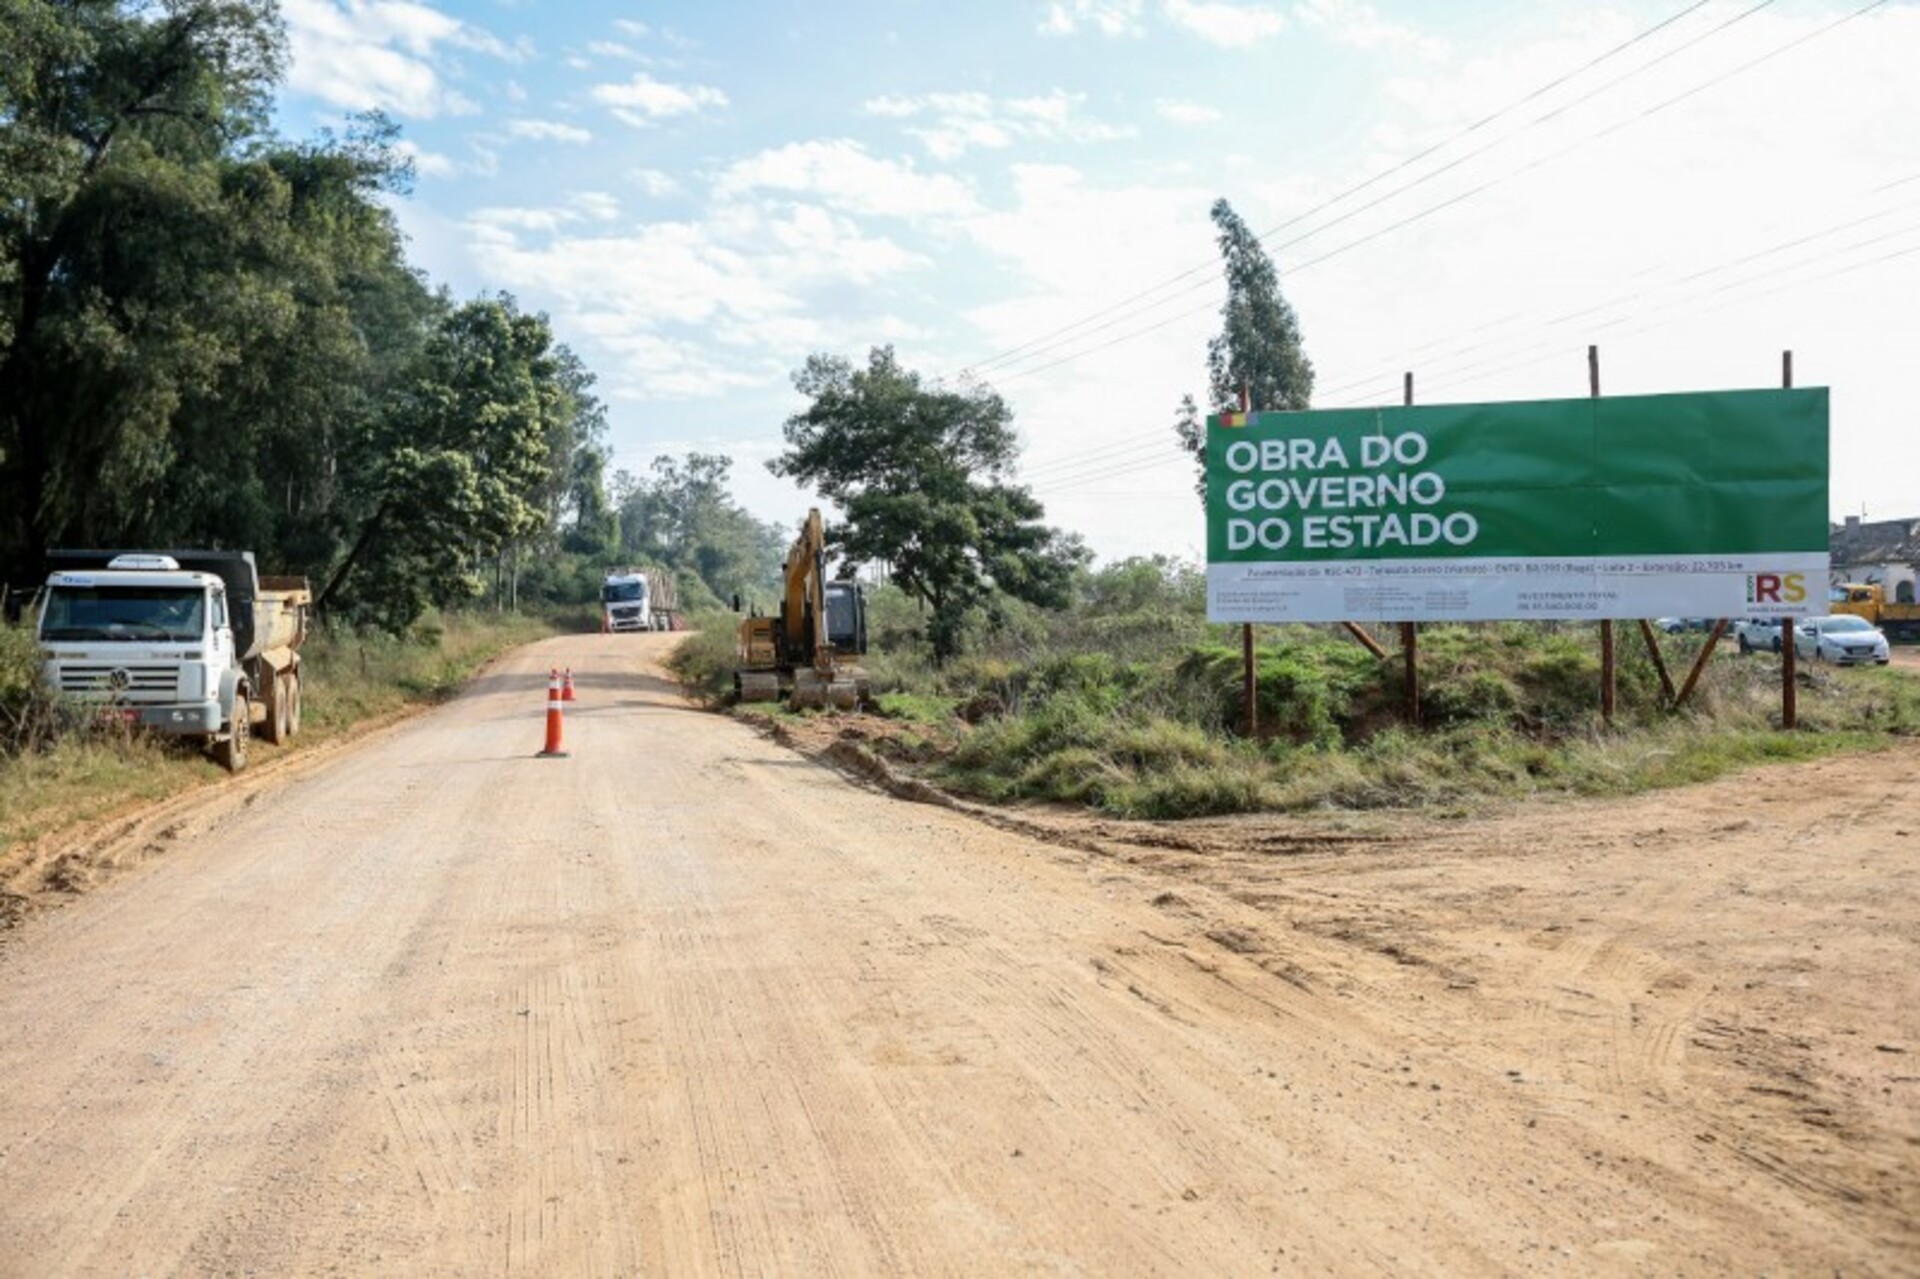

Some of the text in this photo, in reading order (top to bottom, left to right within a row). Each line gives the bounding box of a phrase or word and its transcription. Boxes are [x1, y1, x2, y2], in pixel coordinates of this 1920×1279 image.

[1226, 432, 1428, 473] OBRA DO
[1227, 472, 1445, 512] GOVERNO
[1227, 511, 1478, 550] DO ESTADO
[1756, 572, 1807, 603] RS
